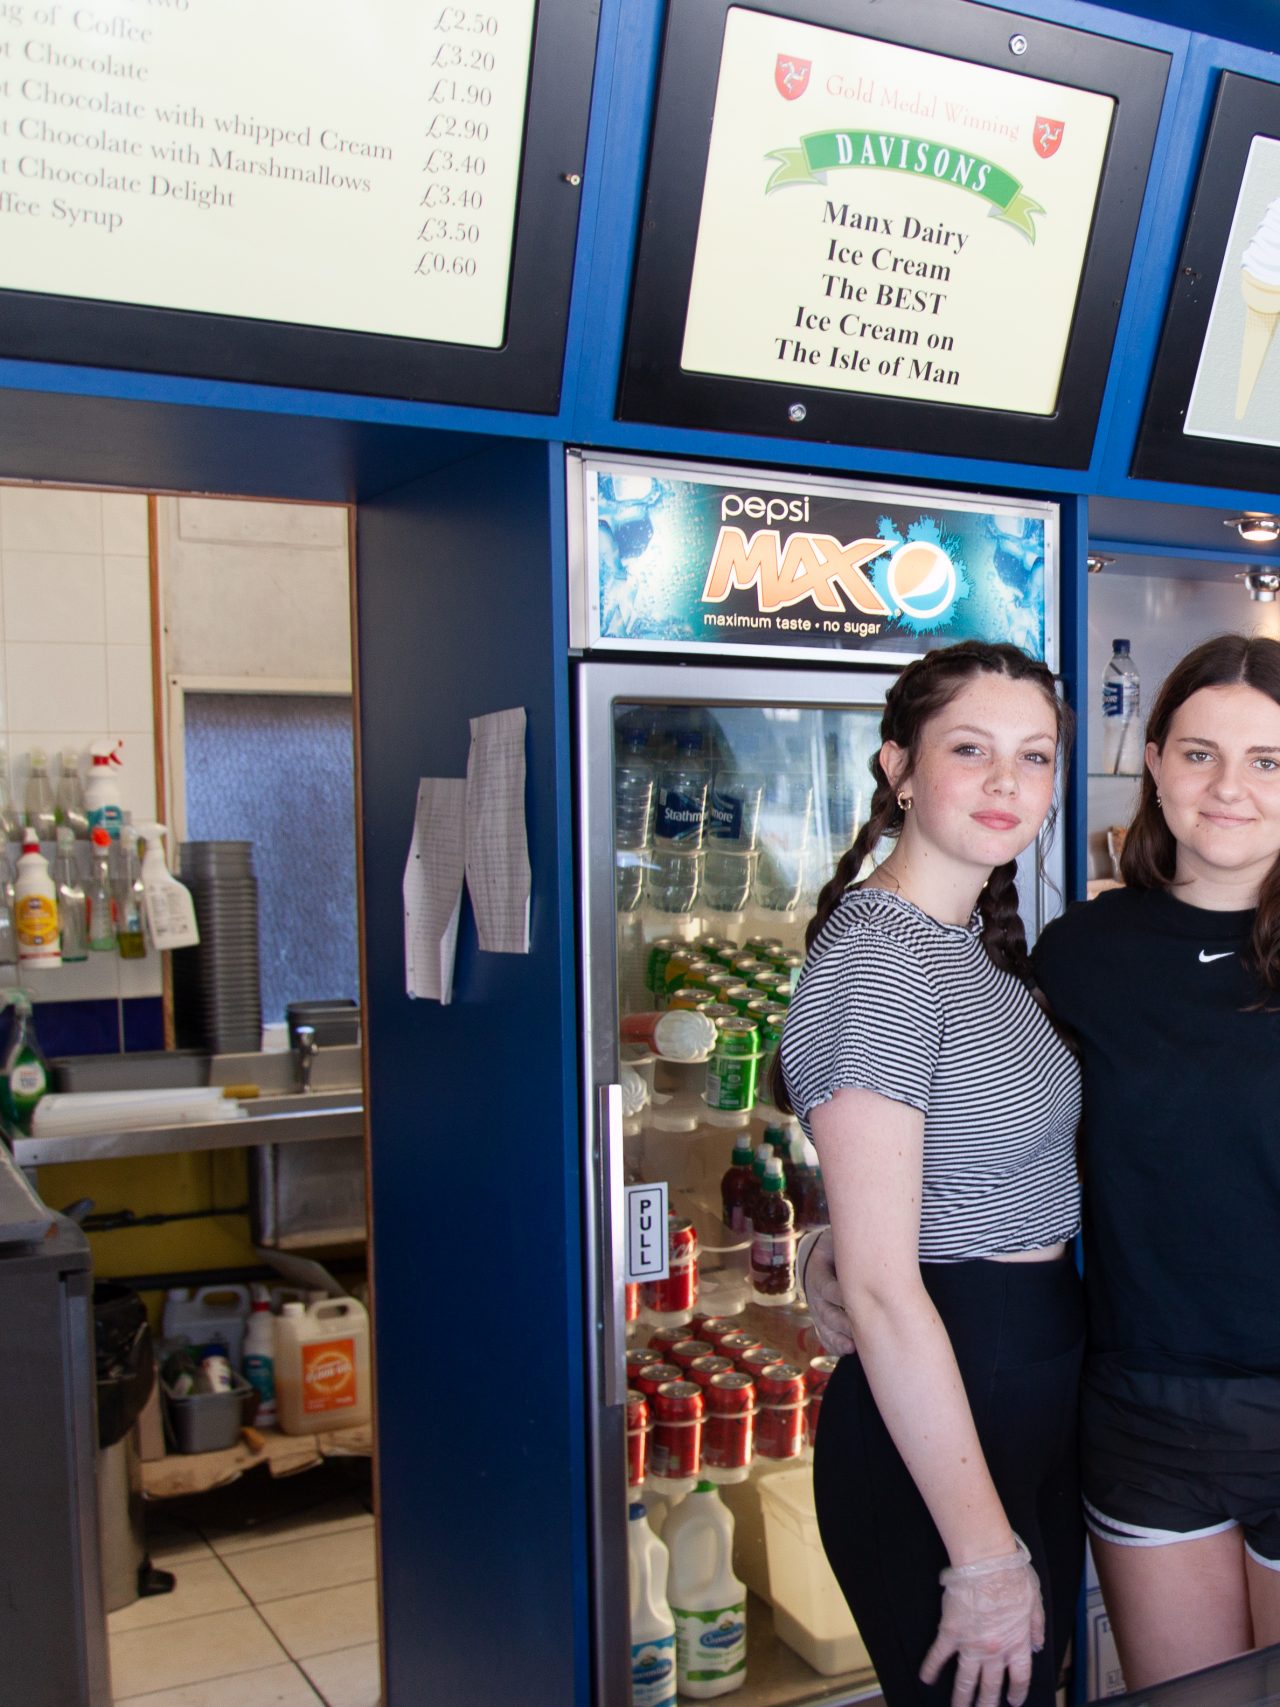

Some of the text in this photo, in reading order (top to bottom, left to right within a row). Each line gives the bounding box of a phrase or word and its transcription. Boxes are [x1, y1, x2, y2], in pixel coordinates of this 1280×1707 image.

[434, 6, 498, 37] £2.50
[34, 5, 60, 25] of
[73, 9, 152, 43] Coffee
[428, 78, 492, 107] £1.90
[431, 42, 495, 72] £3.20
[24, 40, 489, 142] Chocolate £2.90
[826, 75, 1021, 143] Gold Medal Winning
[21, 78, 486, 176] Chocolate with whipped Cream £3.40
[19, 117, 483, 210] Chocolate with Marshmallows £3.40
[835, 133, 992, 193] DAVISONS
[18, 155, 480, 244] Chocolate Delight £3.50
[822, 200, 970, 255] Manx Dairy
[51, 198, 476, 277] Syrup £0.60
[826, 239, 952, 283] Ice Cream
[822, 273, 947, 316] The BEST
[793, 306, 955, 352] Ice Cream on
[774, 337, 961, 387] The Isle of Man
[721, 494, 810, 525] pepsi
[701, 526, 891, 617] MAX
[704, 613, 881, 638] maximum taste no sugar
[640, 1200, 651, 1265] PULL
